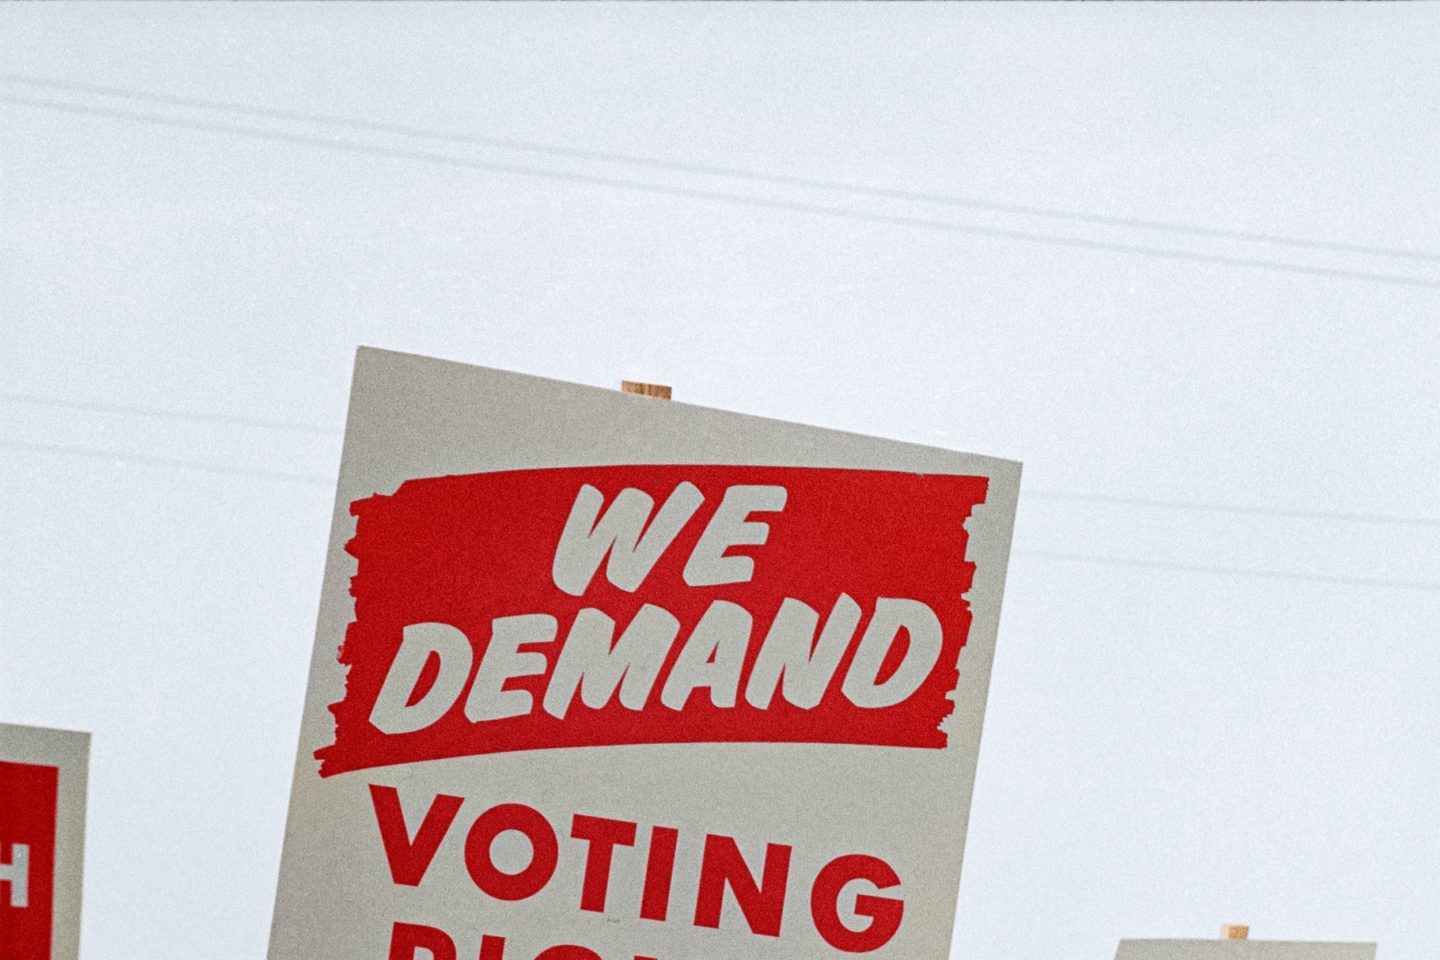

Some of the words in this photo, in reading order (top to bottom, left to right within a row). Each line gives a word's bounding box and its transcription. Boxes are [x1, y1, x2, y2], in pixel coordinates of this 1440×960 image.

[551, 481, 787, 595] WE
[369, 593, 943, 734] DEMAND
[369, 782, 904, 953] VOTING
